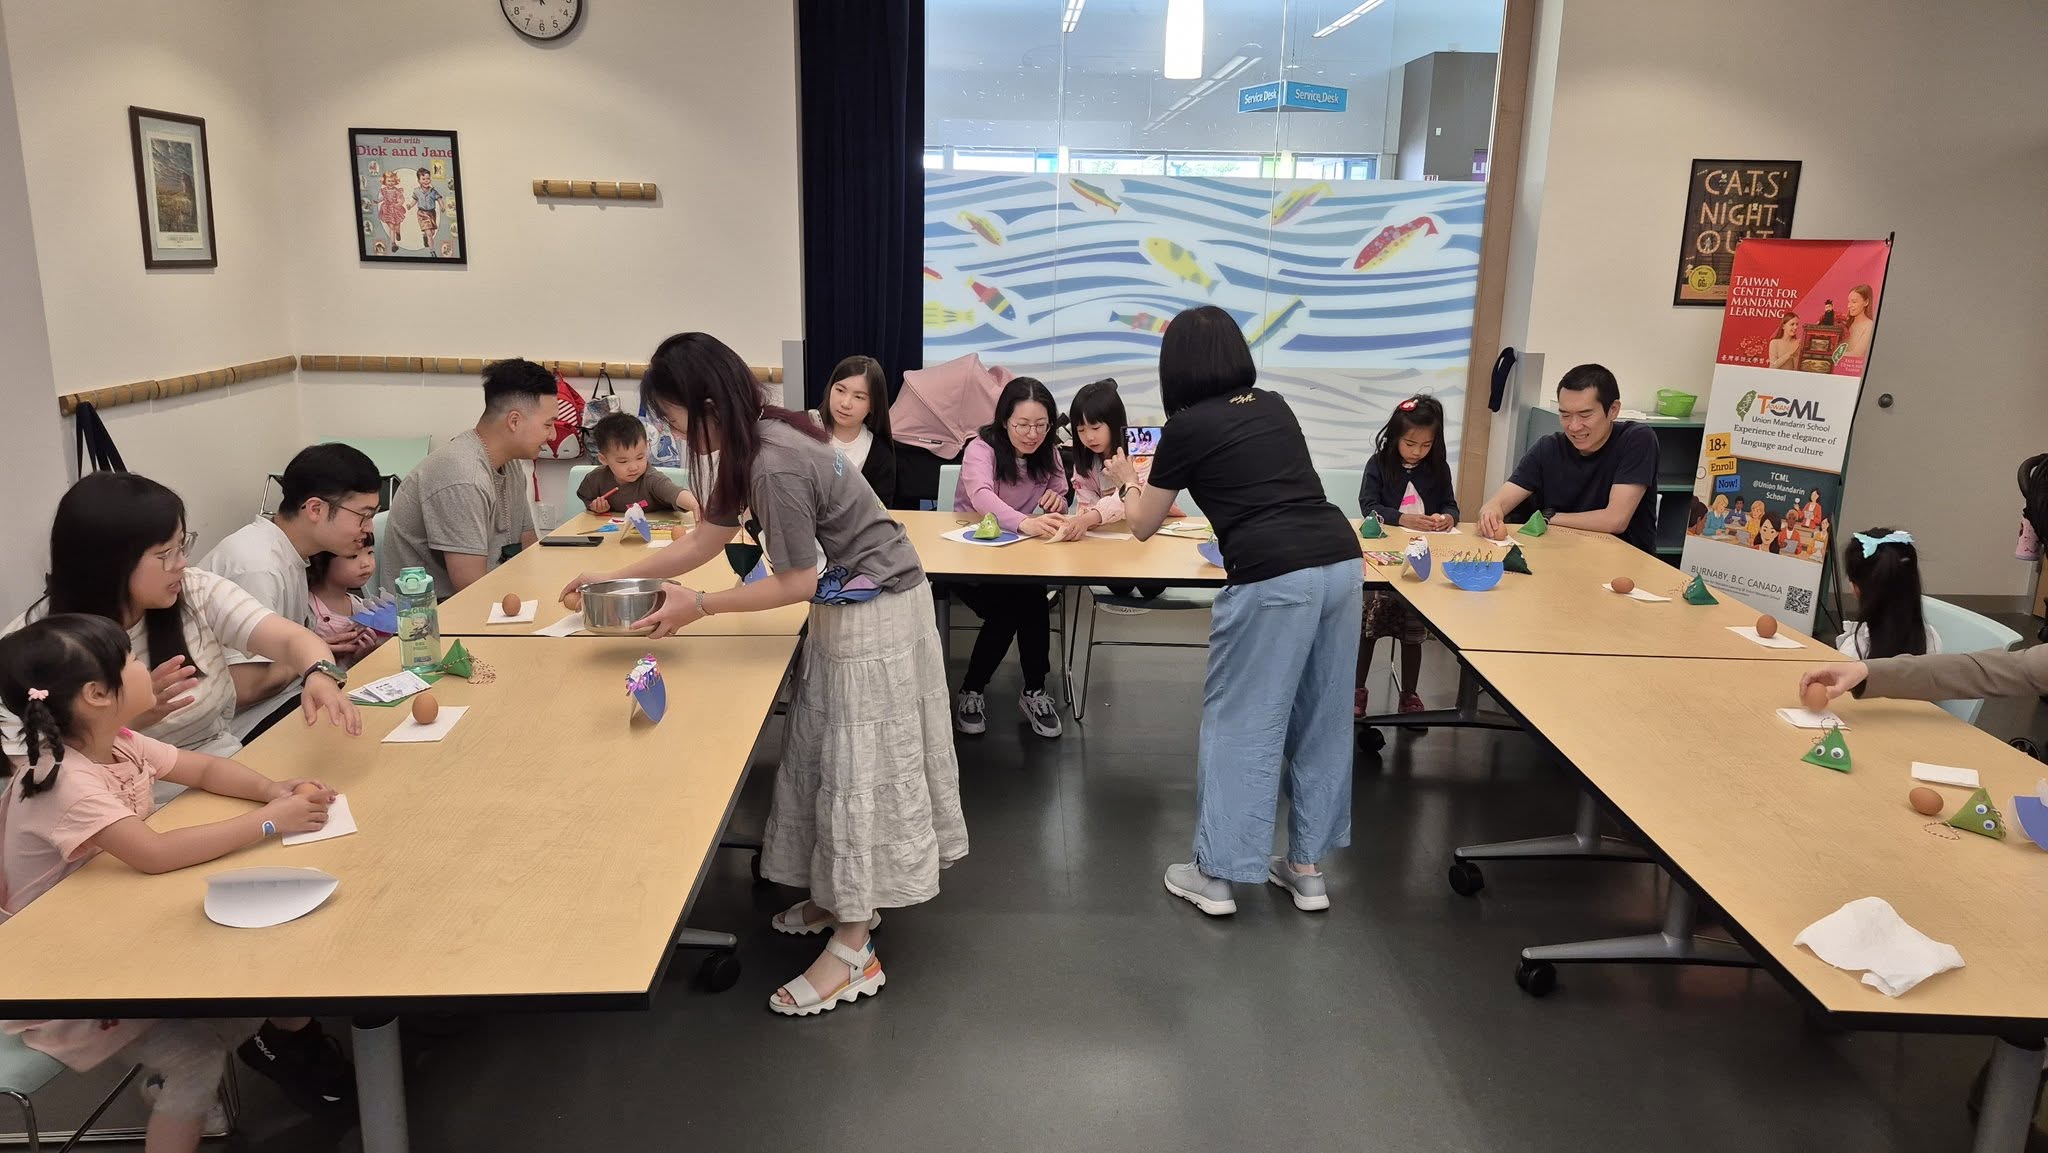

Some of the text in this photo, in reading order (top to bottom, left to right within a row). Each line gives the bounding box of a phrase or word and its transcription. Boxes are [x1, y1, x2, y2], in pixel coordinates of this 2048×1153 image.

[514, 7, 520, 15] 8
[525, 18, 531, 26] 7
[539, 23, 545, 31] 6
[553, 20, 558, 28] 5
[1244, 88, 1277, 105] Service Desk
[1294, 88, 1339, 104] Service Desk
[383, 136, 402, 144] Read
[355, 145, 453, 158] Dick and Jane
[1704, 169, 1789, 199] CATS'
[1699, 202, 1779, 227] NIGHT
[1735, 275, 1780, 288] TAIWAN
[1732, 286, 1775, 298] CENTER
[1776, 288, 1798, 299] FOR
[1730, 297, 1793, 309] MANDARIN
[1729, 306, 1785, 319] LEARNING
[1757, 394, 1826, 422] TCML
[1751, 415, 1831, 433] Union Mandarin School
[1733, 424, 1838, 445] Experience the elegance of
[1709, 438, 1728, 451] 18+
[1740, 437, 1824, 457] language and culture
[1710, 460, 1735, 472] Enroll
[1718, 478, 1738, 489] Now!
[1770, 471, 1790, 483] TCML
[1752, 480, 1806, 496] @Union Mandarin
[1765, 491, 1786, 502] School
[1747, 578, 1783, 594] CANADA
